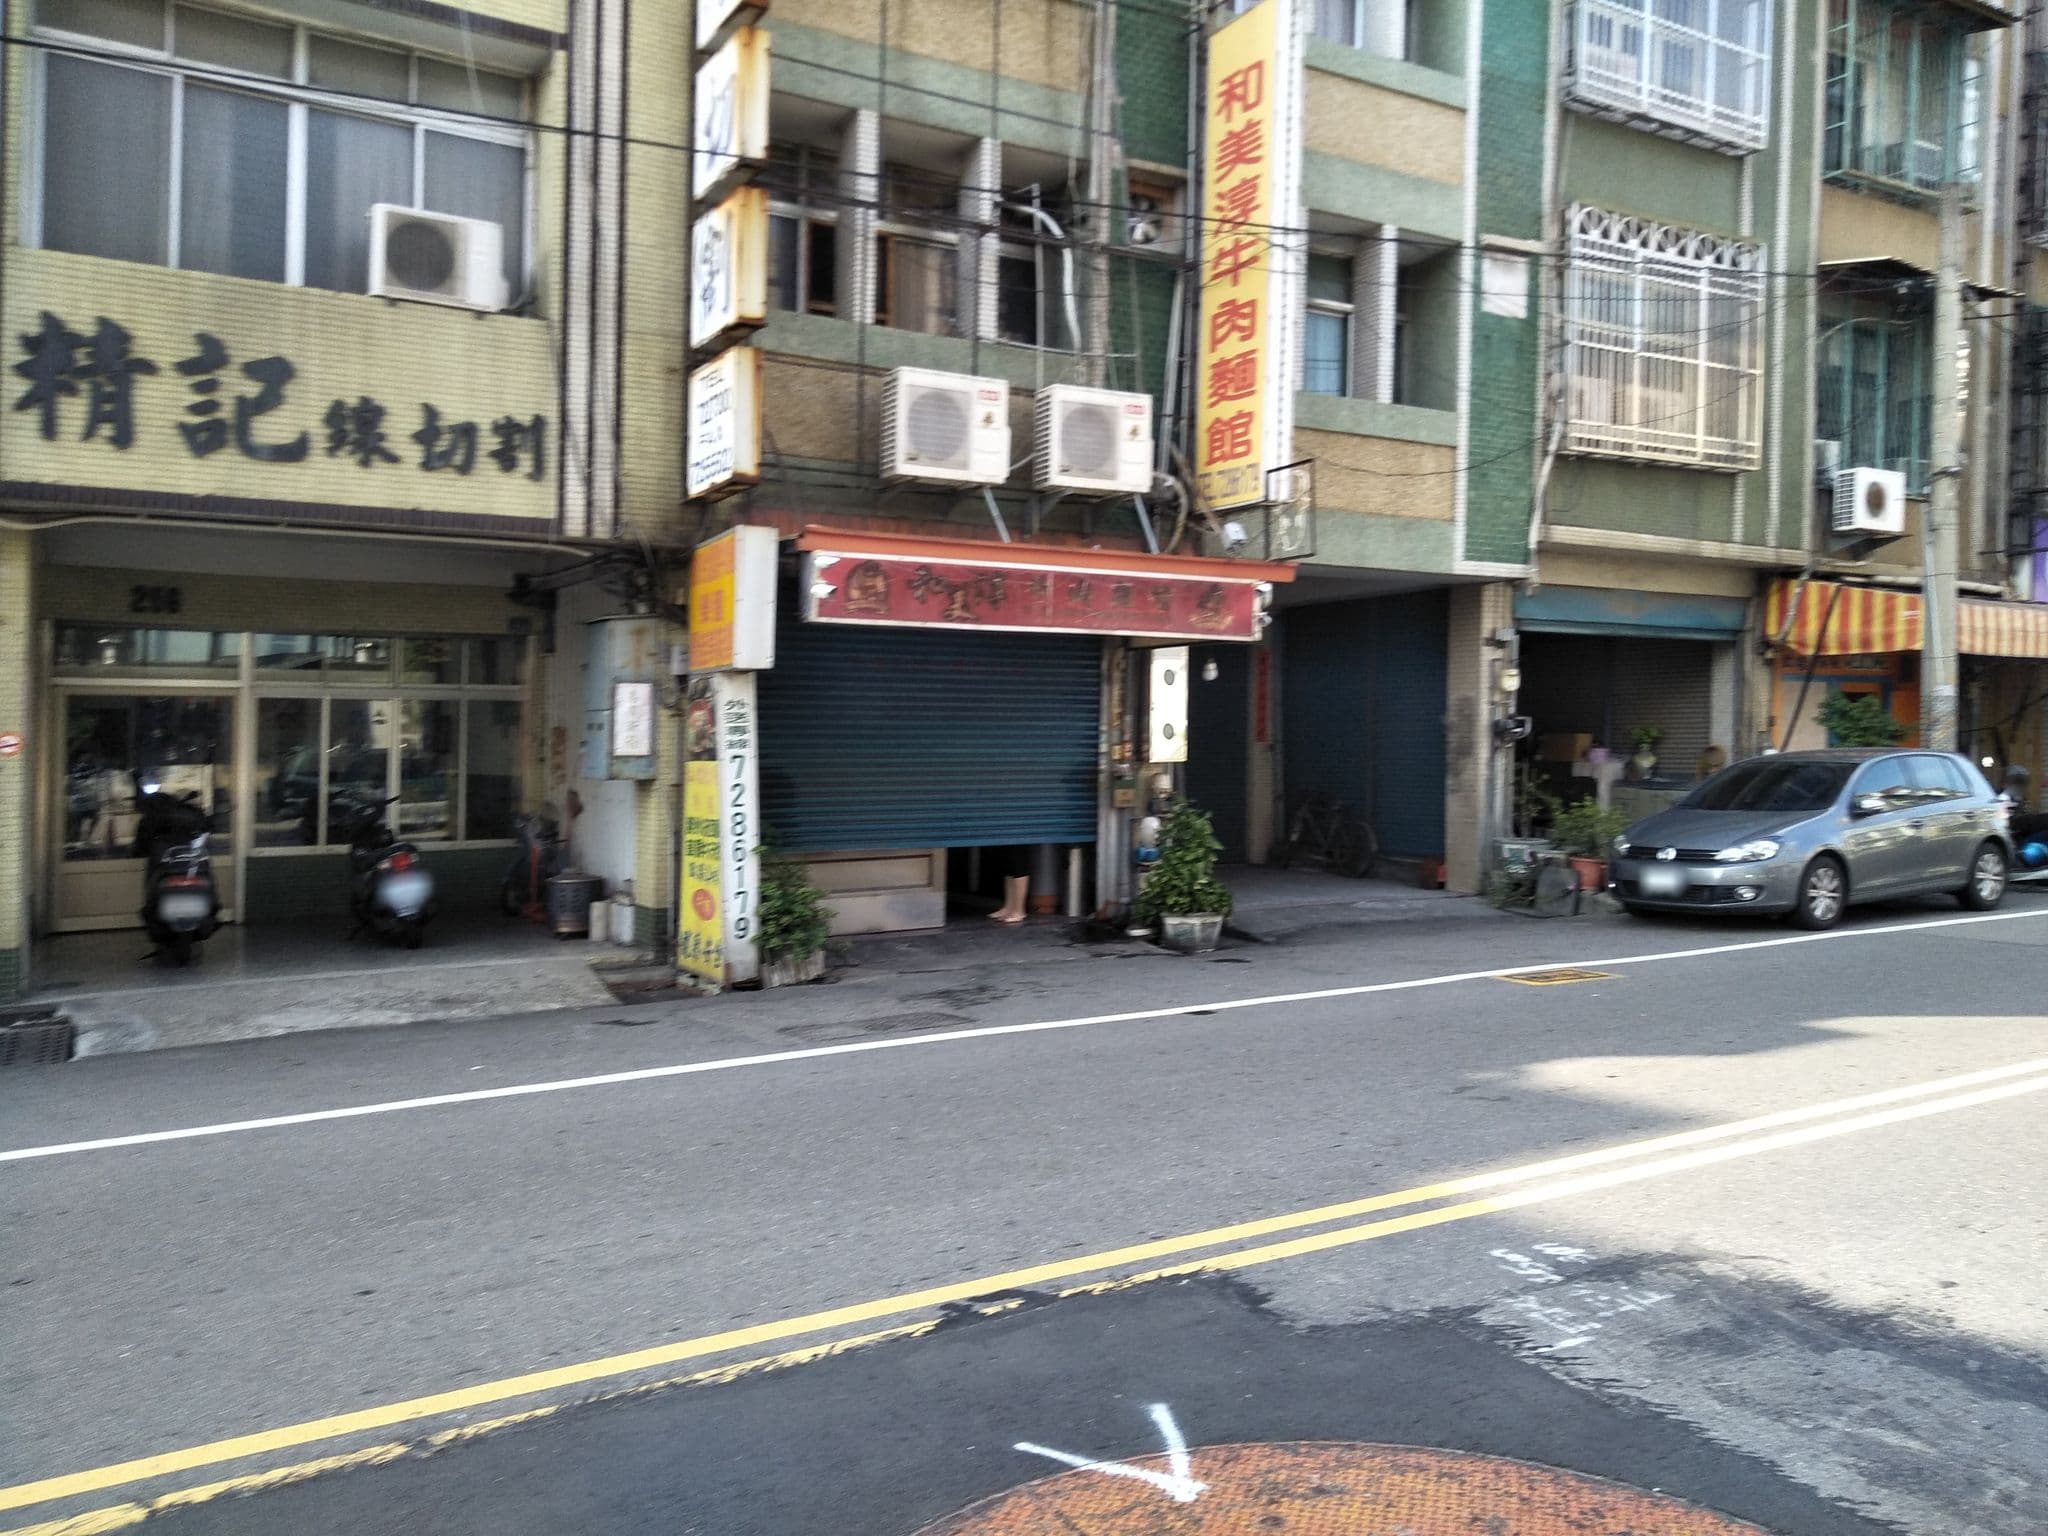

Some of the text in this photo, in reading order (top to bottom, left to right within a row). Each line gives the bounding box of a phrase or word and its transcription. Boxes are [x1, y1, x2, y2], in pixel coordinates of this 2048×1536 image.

[1205, 59, 1264, 466] 和美淳牛肉麵館
[730, 755, 749, 940] 7286179
